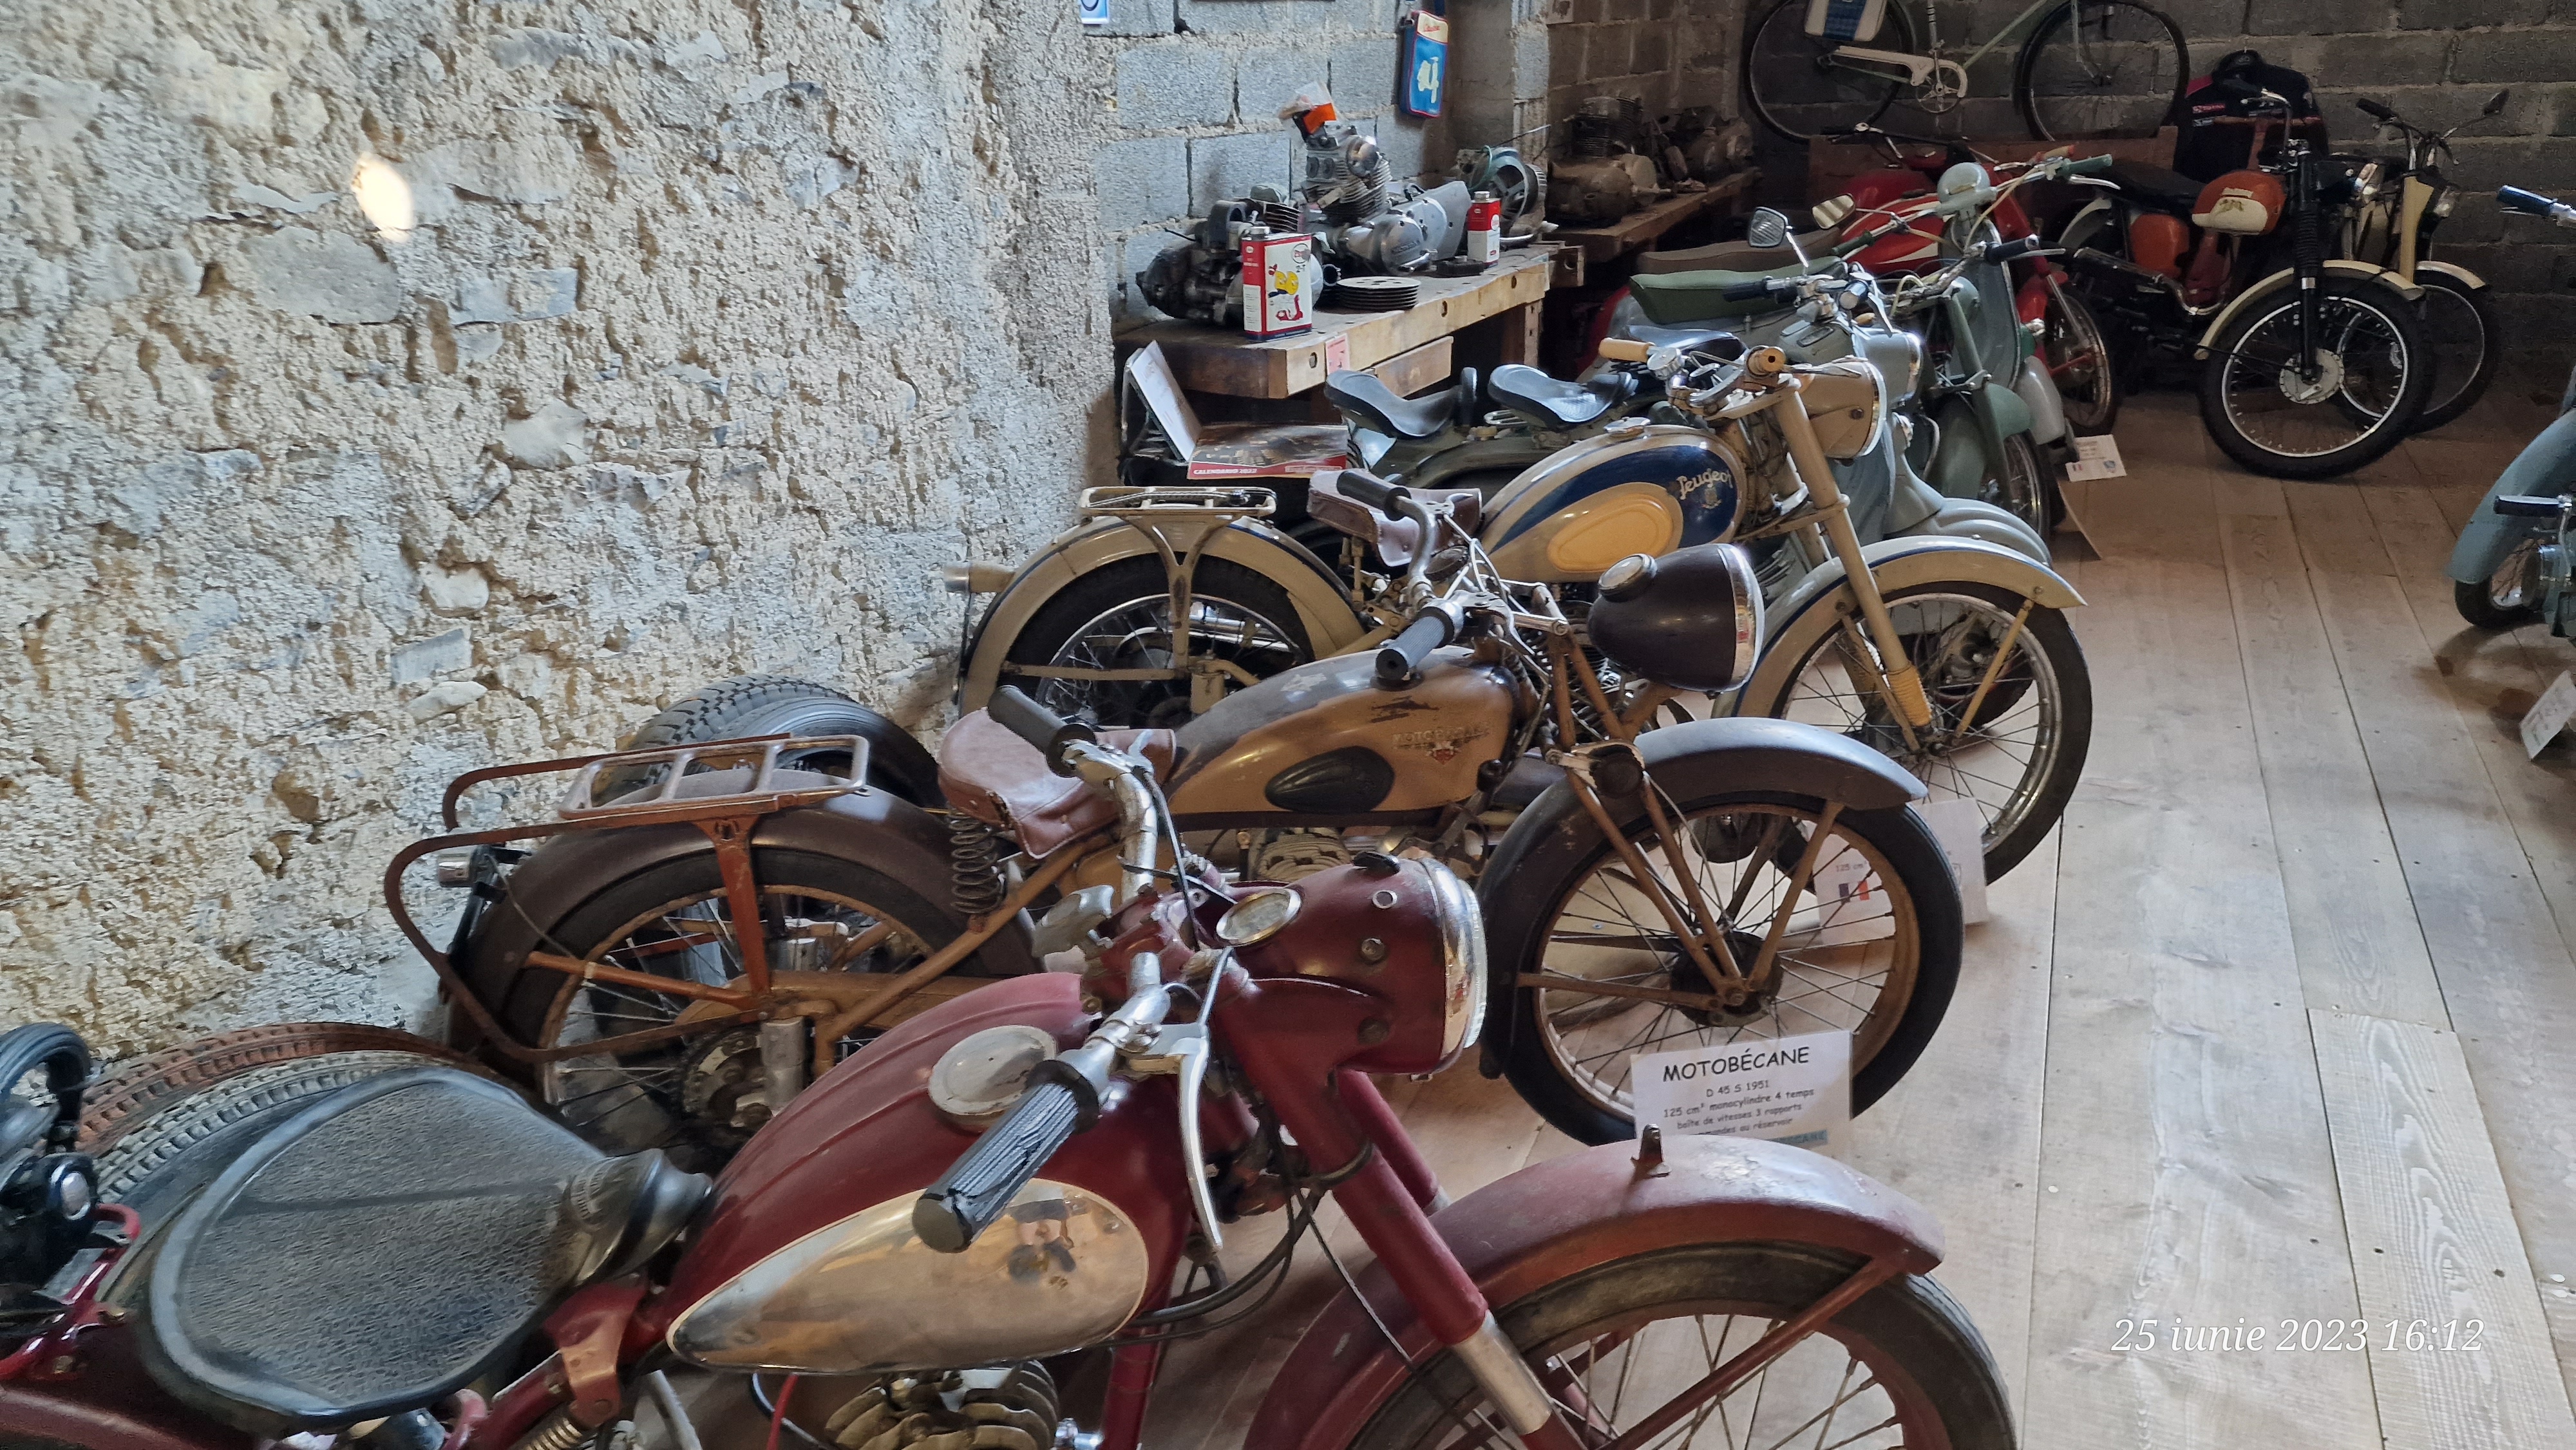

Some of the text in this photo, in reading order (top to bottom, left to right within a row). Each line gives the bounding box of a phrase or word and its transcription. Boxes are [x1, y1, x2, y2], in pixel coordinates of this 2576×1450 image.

[1676, 467, 1734, 500] Peugeot
[1662, 1046, 1810, 1082] MOTOBÉCANE
[1706, 1080, 1770, 1098] D 45 S 1951
[1663, 1107, 1682, 1118] 125
[1709, 1094, 1771, 1111] monocylindre
[1775, 1091, 1782, 1100] 4
[1785, 1089, 1814, 1099] temps
[1677, 1103, 1802, 1129] boîte de vitesses 3 rapports
[1753, 1117, 1793, 1129] réservoir
